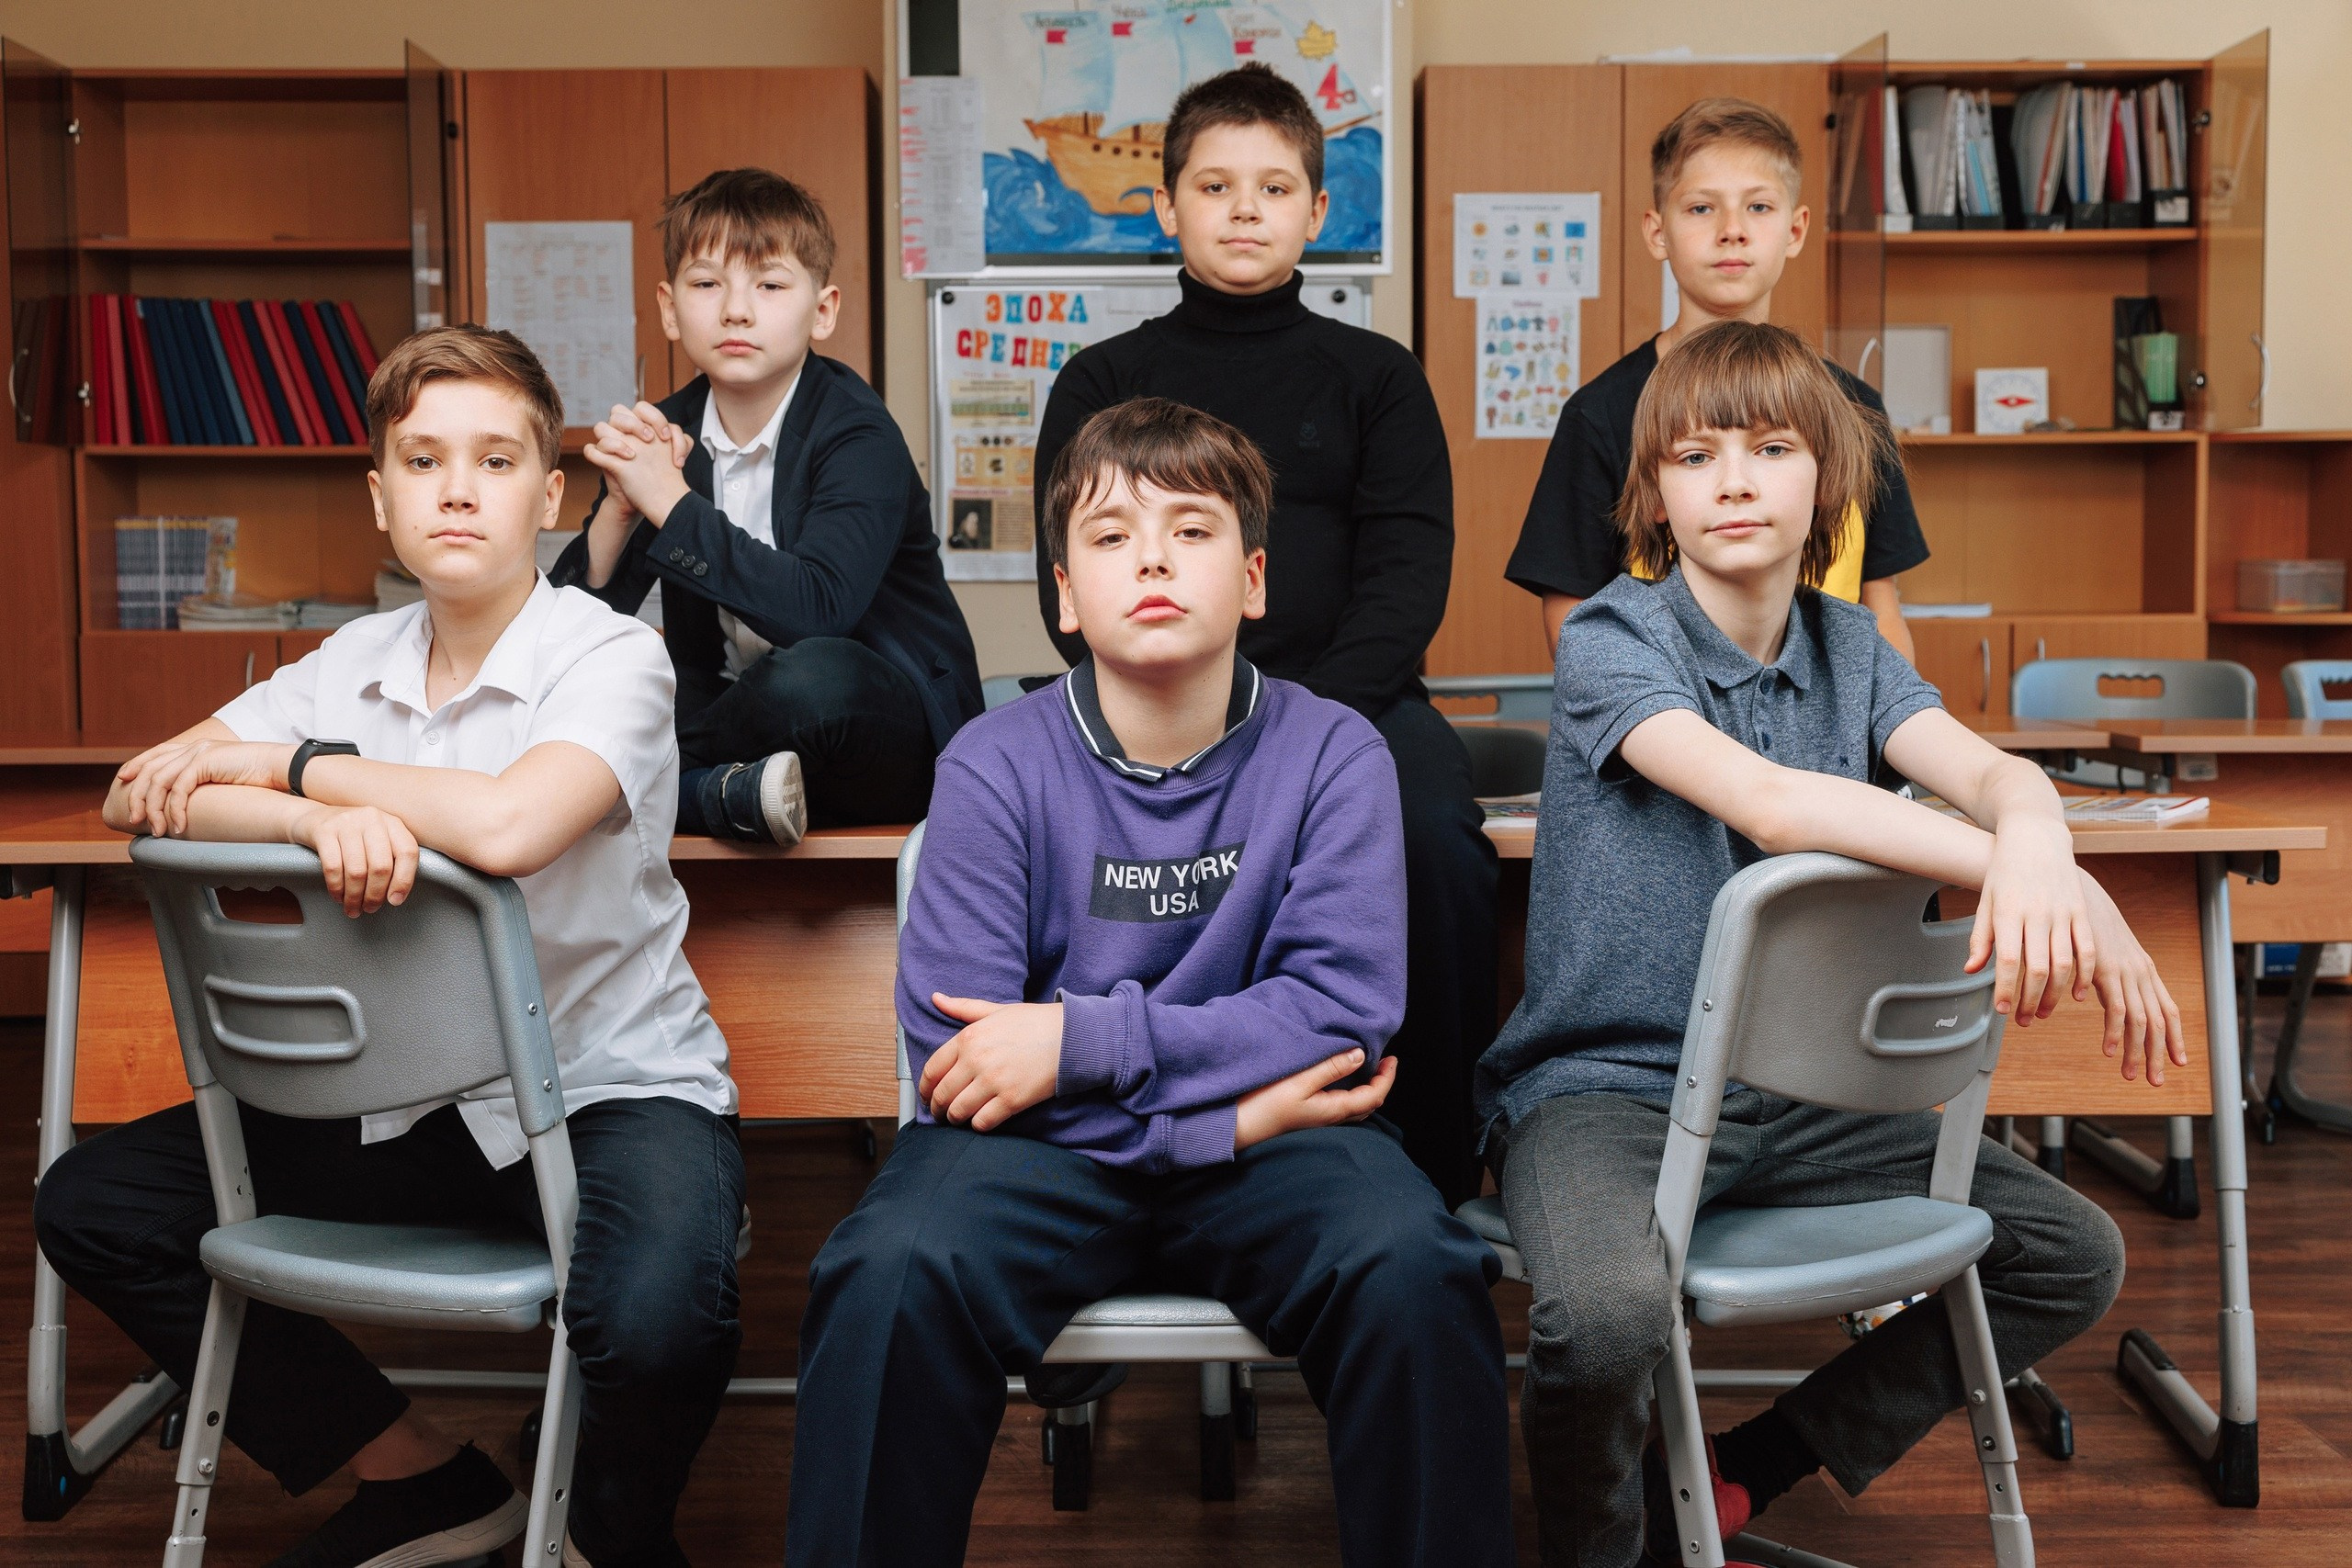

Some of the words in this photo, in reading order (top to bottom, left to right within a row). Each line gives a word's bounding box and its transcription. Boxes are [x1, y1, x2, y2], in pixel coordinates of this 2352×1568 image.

[986, 291, 1088, 323] ЭПОХА
[1104, 863, 1162, 889] NEW
[1170, 850, 1239, 887] YORK
[1149, 890, 1200, 916] USA
